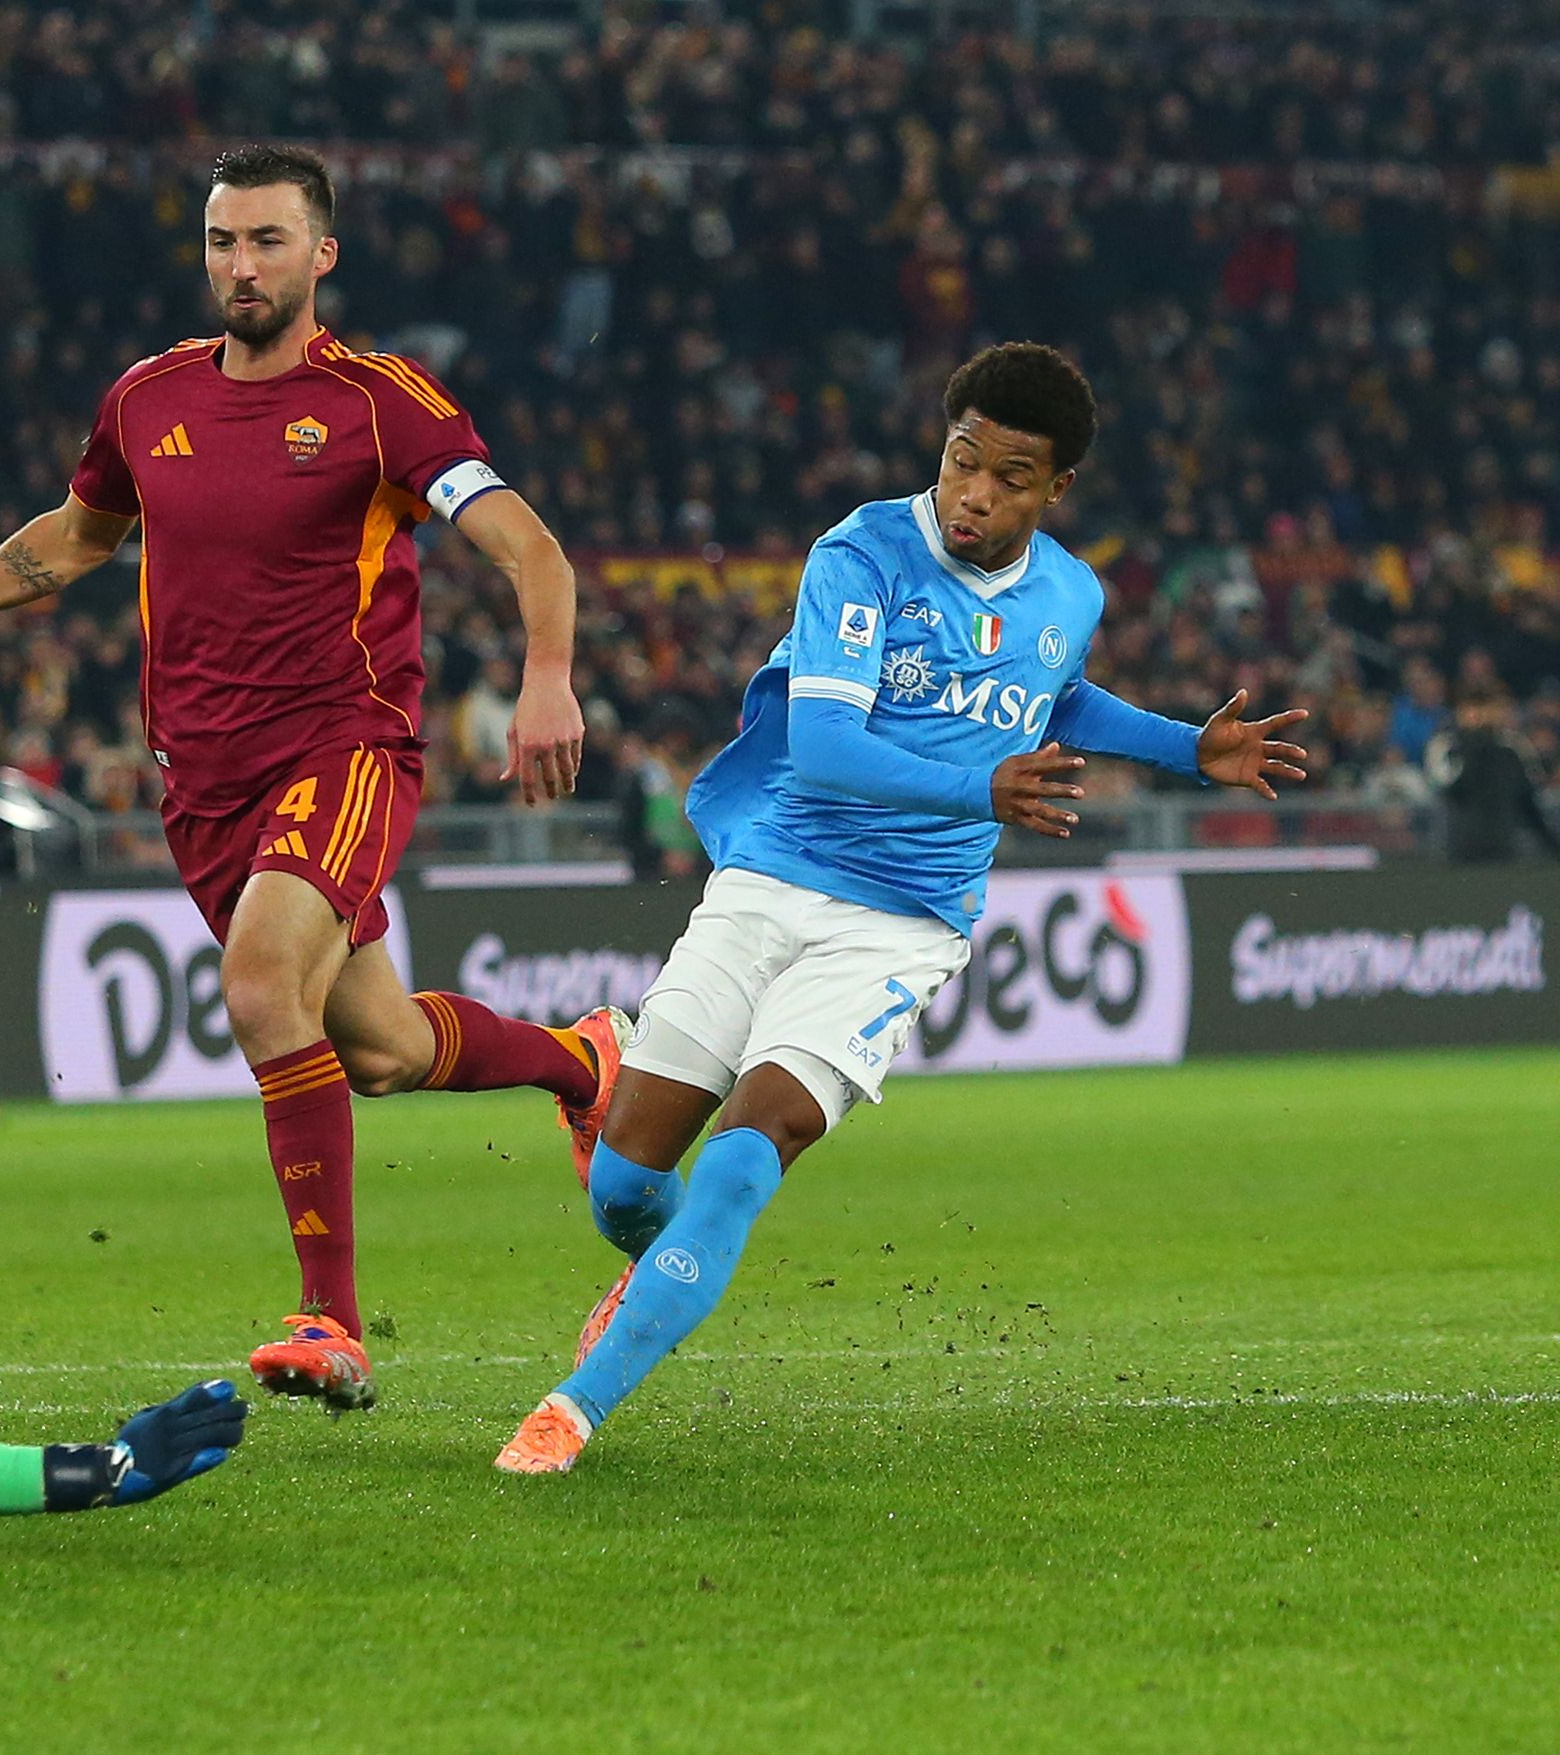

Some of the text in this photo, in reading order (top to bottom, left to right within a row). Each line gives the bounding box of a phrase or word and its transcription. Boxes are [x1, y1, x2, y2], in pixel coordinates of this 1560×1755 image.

[901, 603, 943, 627] EA7
[1044, 635, 1059, 657] N
[930, 671, 1052, 736] MSC
[275, 776, 318, 822] 4
[1230, 904, 1546, 1010] Supermercati
[858, 977, 918, 1041] 7
[846, 1036, 883, 1068] EA7
[283, 1160, 322, 1182] ASR
